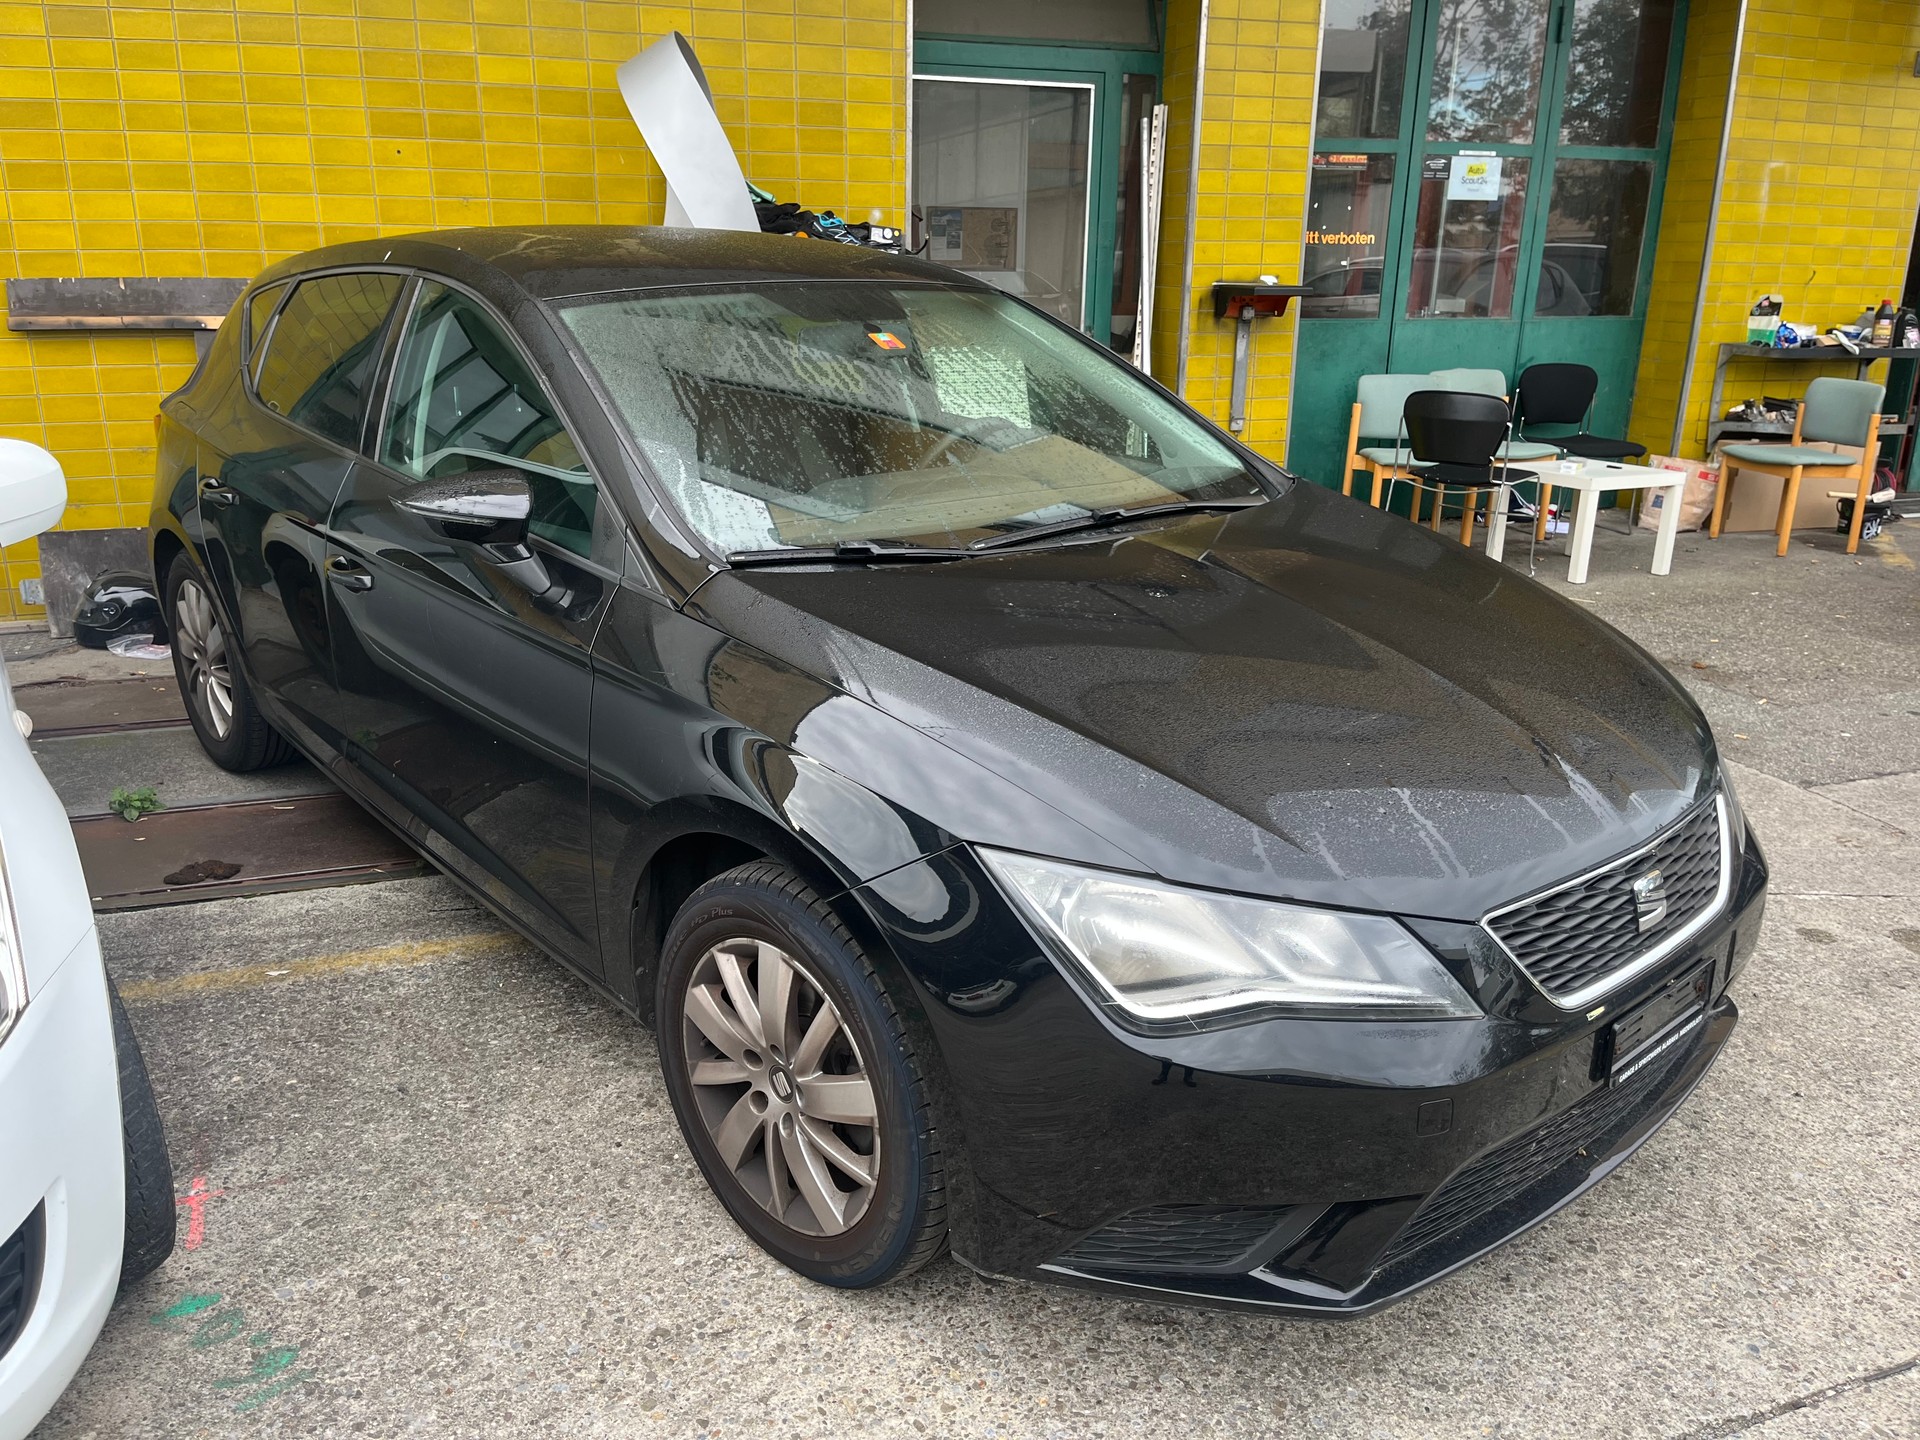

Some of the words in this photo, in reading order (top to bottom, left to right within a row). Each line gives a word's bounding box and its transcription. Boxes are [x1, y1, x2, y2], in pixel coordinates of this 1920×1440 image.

[1467, 165, 1484, 175] Auto
[1460, 176, 1488, 185] Scout24
[1321, 231, 1375, 245] verboten
[711, 905, 733, 918] Plus
[835, 977, 866, 1032] OUTSIDE
[830, 1193, 905, 1278] NEXEN
